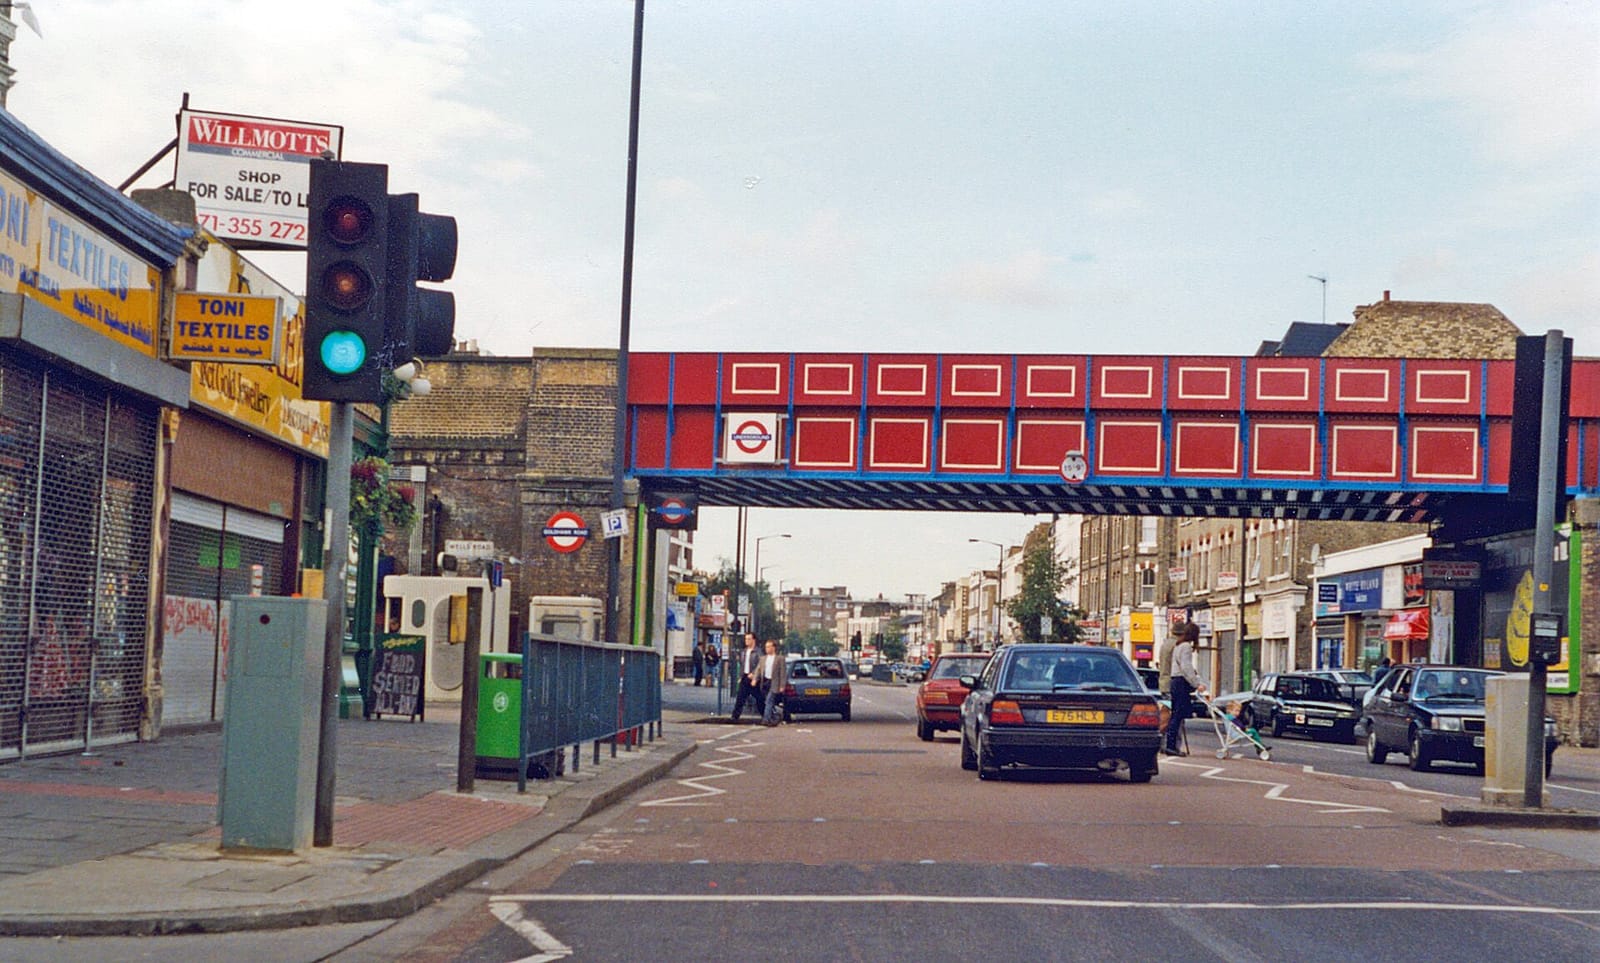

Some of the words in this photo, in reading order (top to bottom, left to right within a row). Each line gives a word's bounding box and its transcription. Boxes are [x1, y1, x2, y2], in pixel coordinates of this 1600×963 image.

[192, 118, 330, 154] WILLMOTTS
[231, 147, 284, 160] COMMERCIAL
[238, 170, 281, 184] SHOP
[188, 182, 217, 199] FOR
[297, 193, 309, 208] L
[195, 213, 262, 236] 71-355
[48, 215, 130, 301] TEXTILES
[198, 299, 245, 317] TONI
[177, 321, 270, 341] TEXTILES
[1052, 711, 1073, 721] E75
[1076, 711, 1098, 721] HLX
